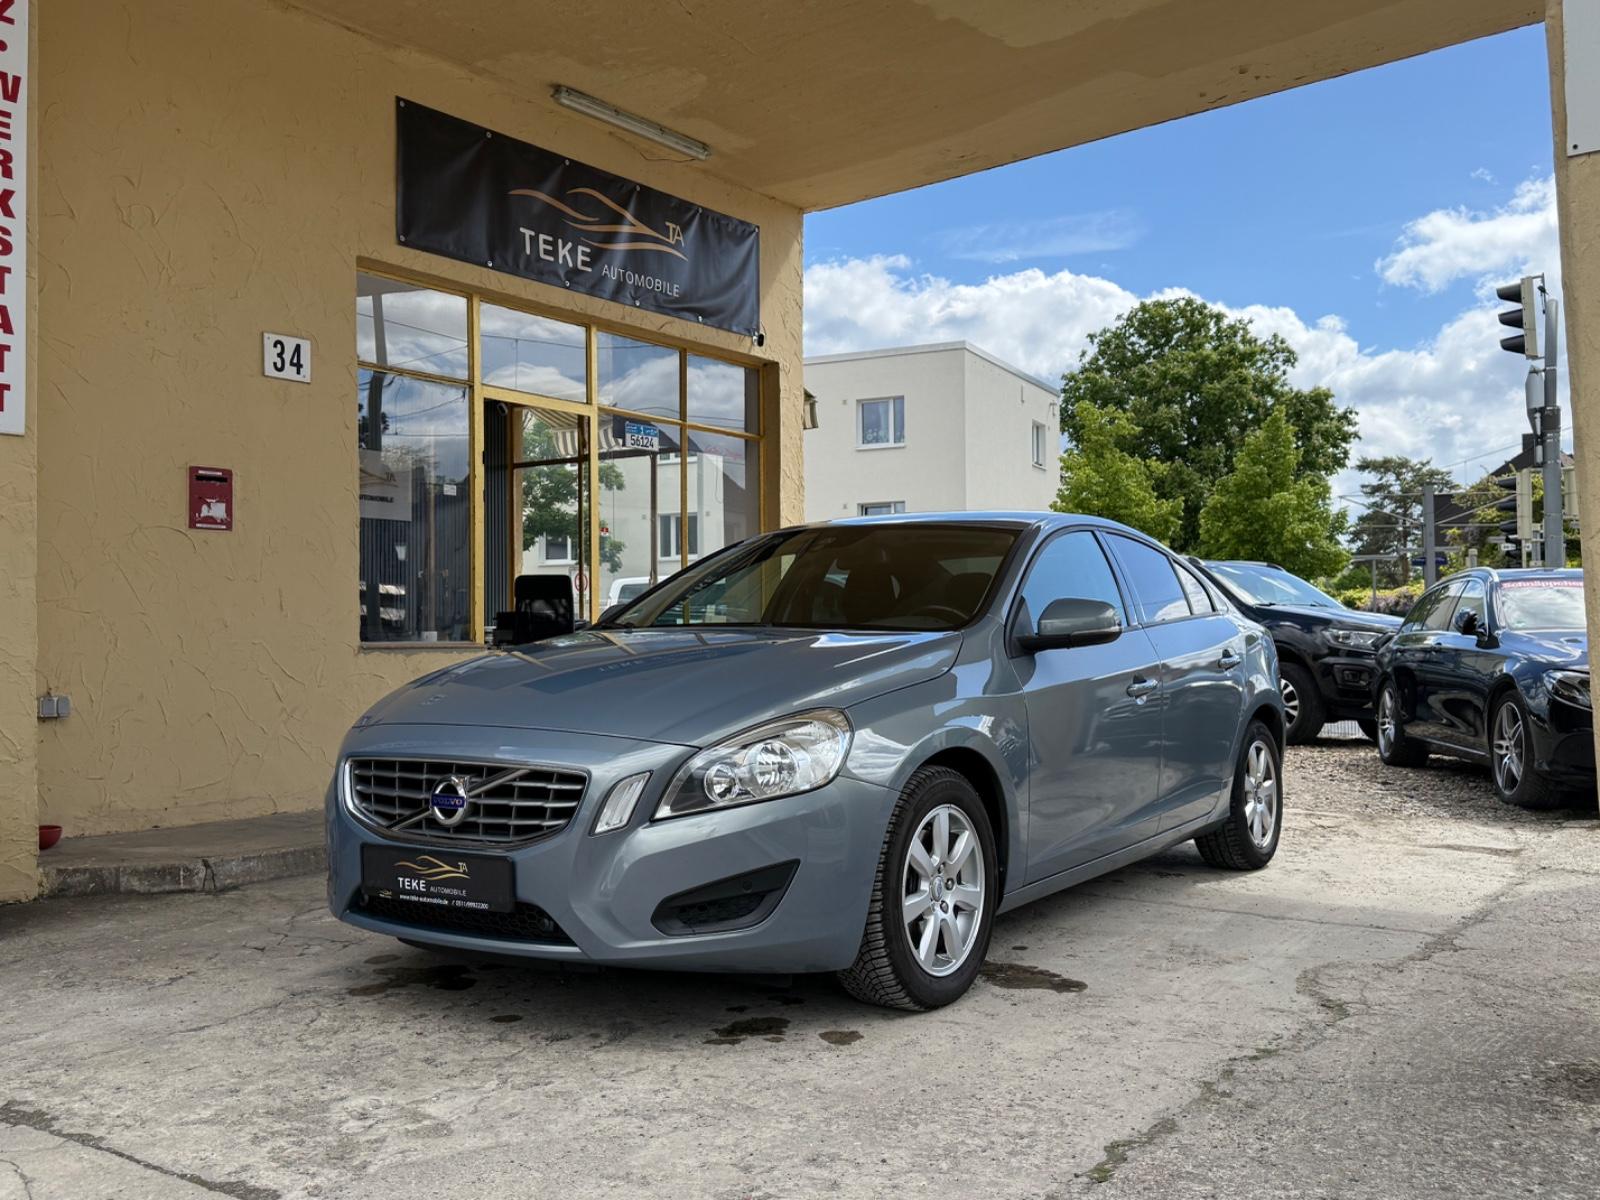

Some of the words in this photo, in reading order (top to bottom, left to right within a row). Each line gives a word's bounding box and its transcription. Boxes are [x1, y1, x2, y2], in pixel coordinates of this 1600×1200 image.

[519, 227, 593, 272] TEKE
[601, 264, 680, 297] AUTOMOBILE
[272, 339, 303, 375] 34
[630, 434, 654, 448] 56124
[432, 797, 463, 806] VOLVO
[397, 877, 427, 892] TEKE
[430, 886, 467, 896] AUTOMOBILE
